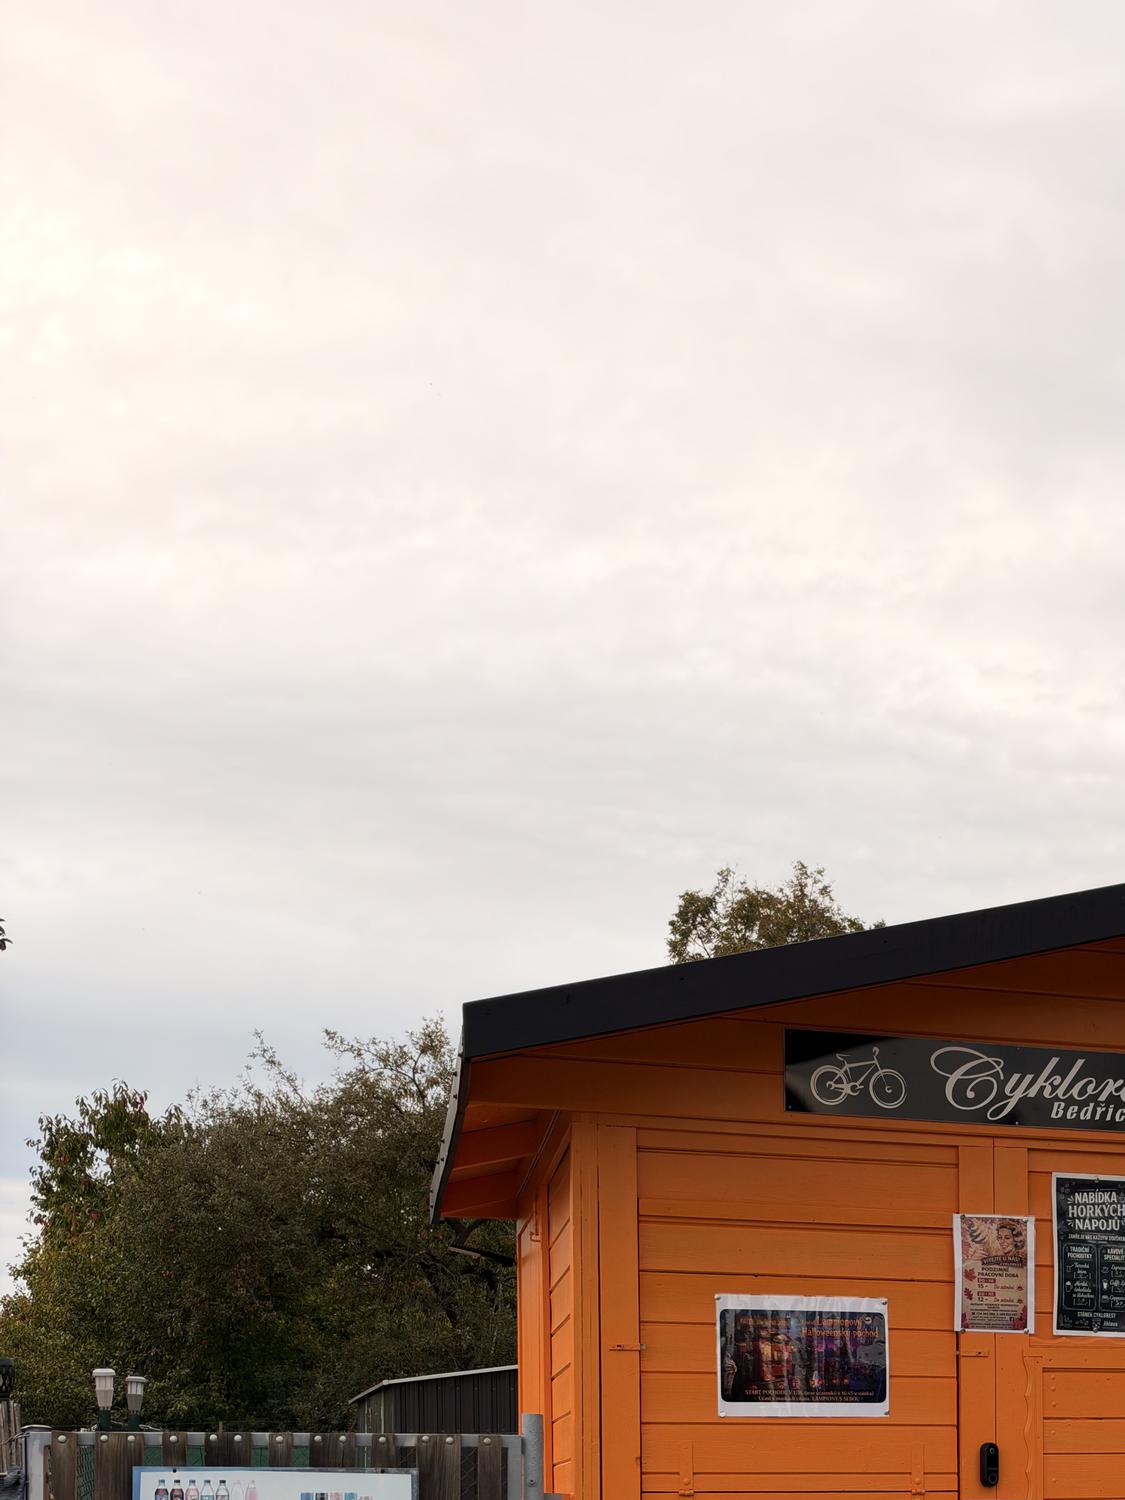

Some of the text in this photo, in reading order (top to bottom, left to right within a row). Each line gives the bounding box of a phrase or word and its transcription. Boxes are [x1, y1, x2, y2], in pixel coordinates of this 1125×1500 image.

[1074, 1188, 1118, 1204] NABÍDKA
[1068, 1203, 1125, 1218] HORKÝCH
[1075, 1216, 1120, 1231] NÁPOJŮ
